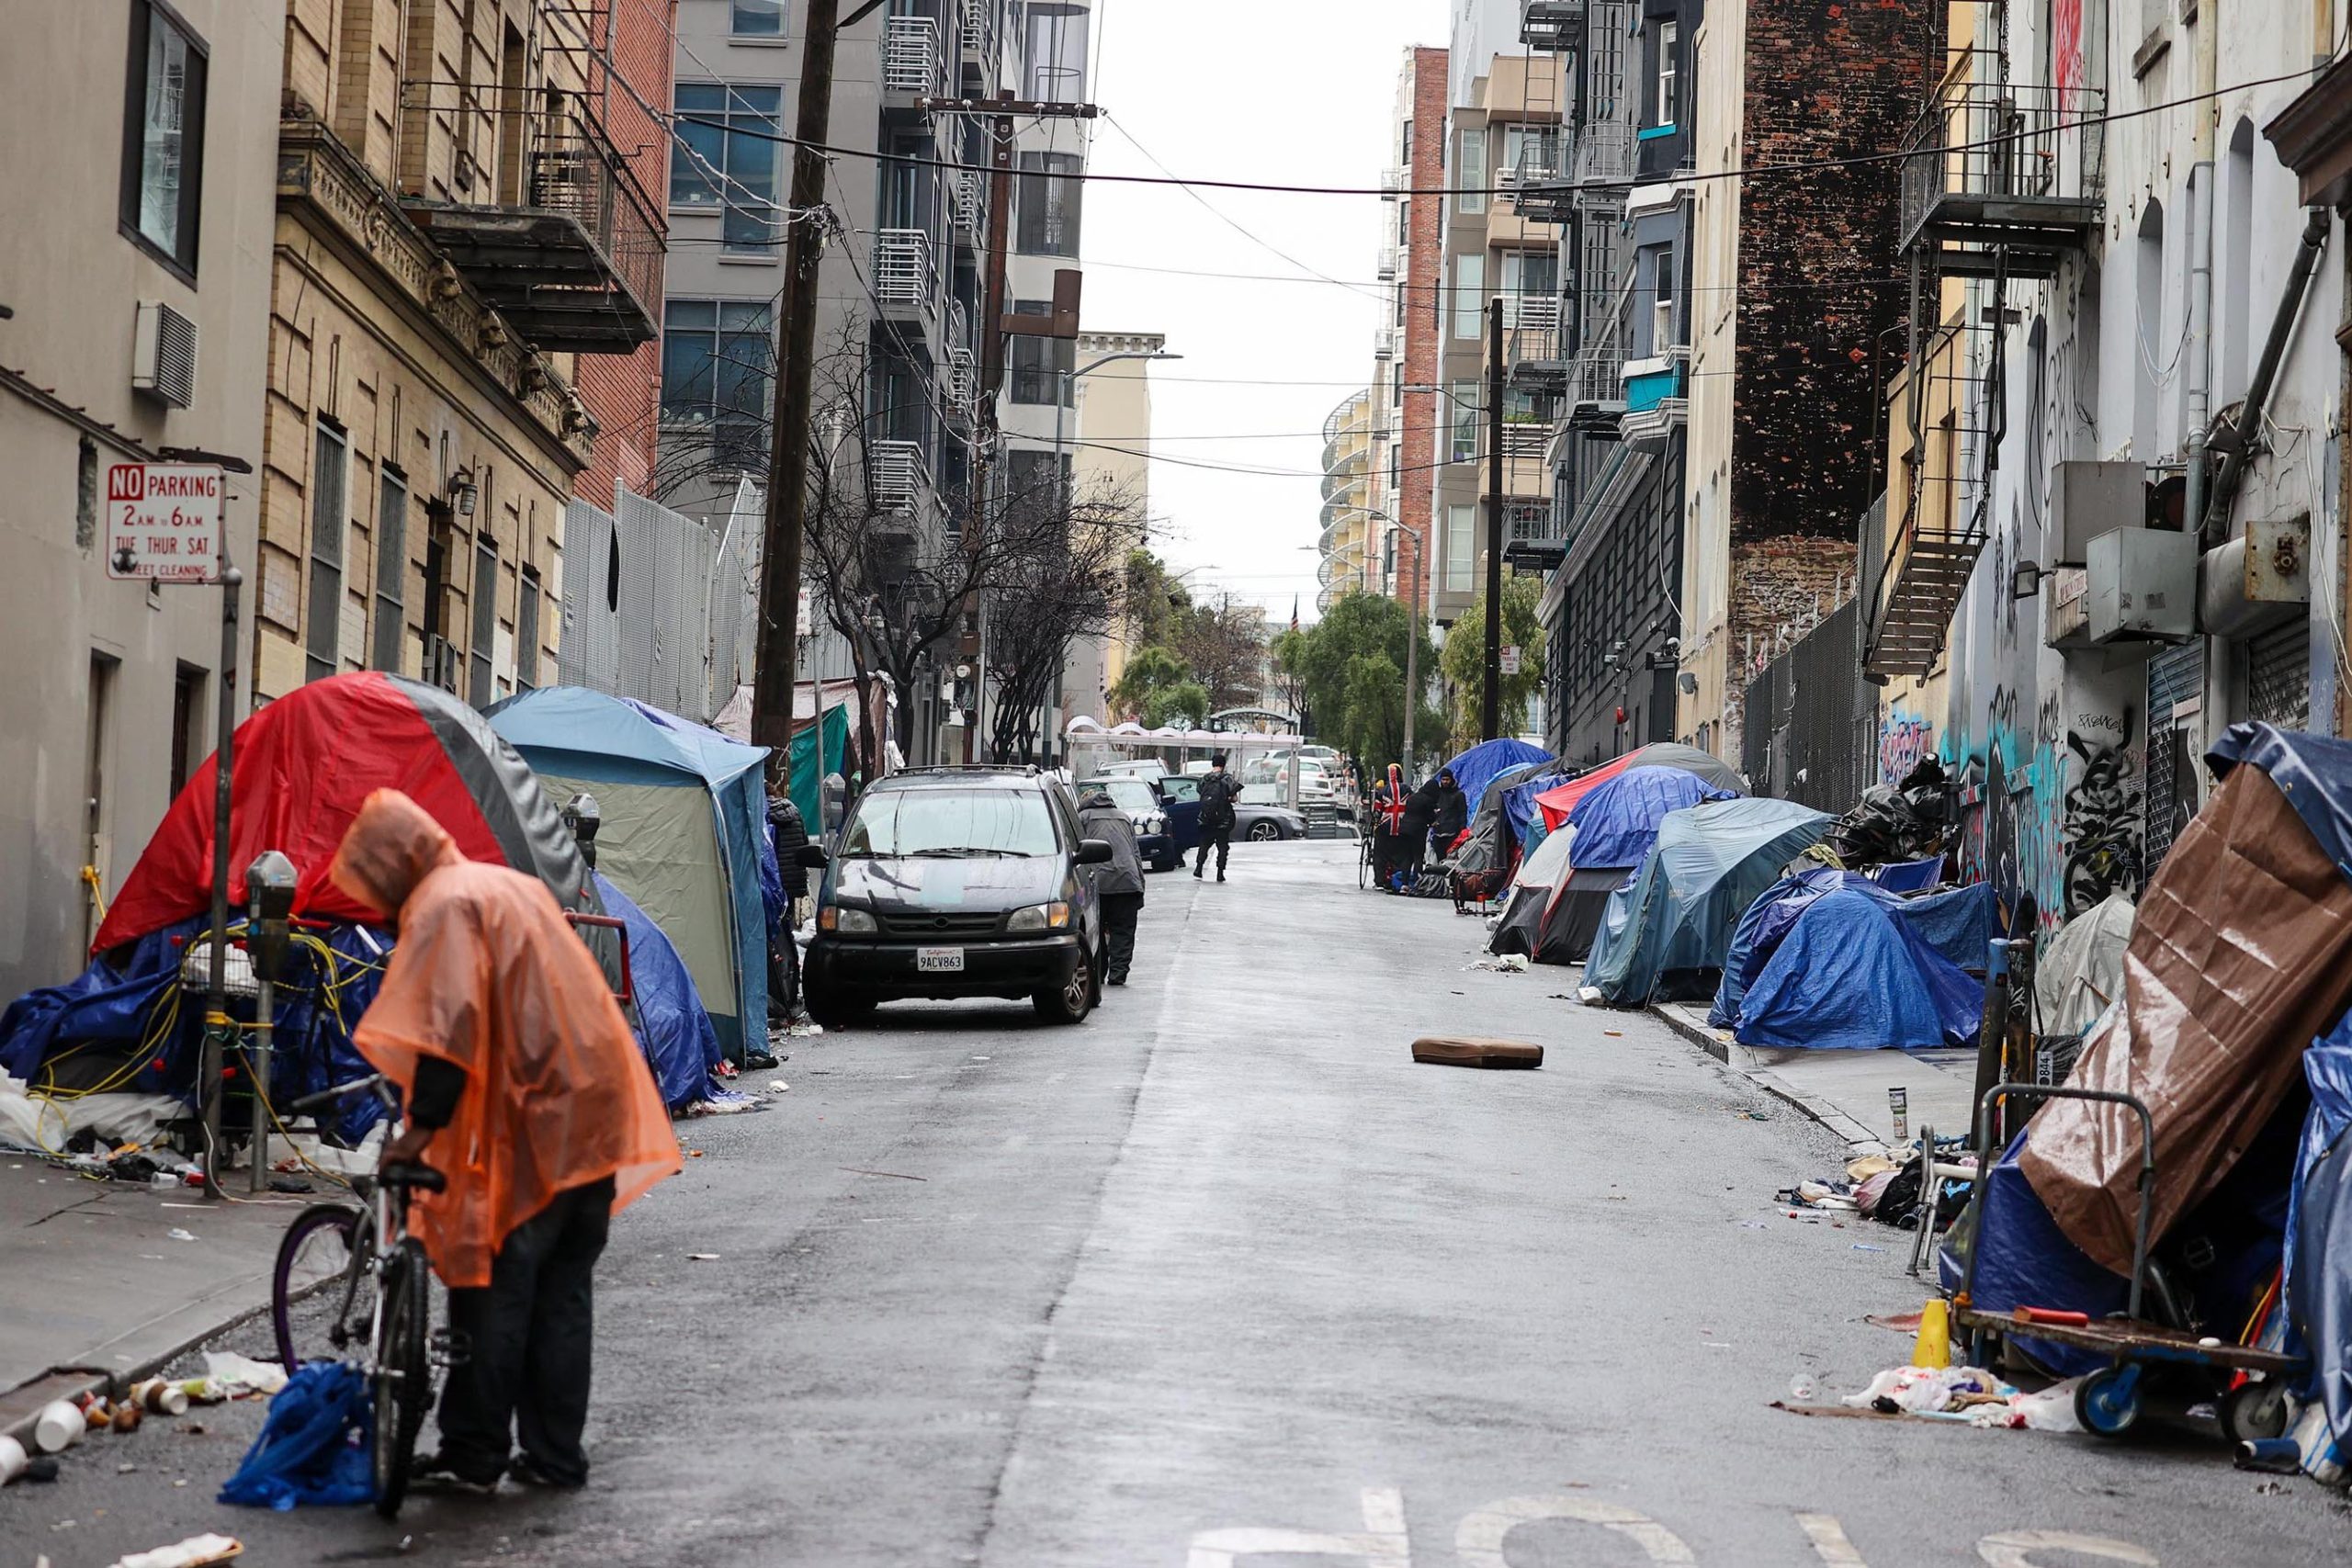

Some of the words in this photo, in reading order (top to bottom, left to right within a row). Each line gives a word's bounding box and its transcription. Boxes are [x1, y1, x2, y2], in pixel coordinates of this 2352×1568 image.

[111, 468, 141, 498] NO
[148, 475, 216, 497] PARKING
[159, 564, 207, 576] CLEANING
[921, 956, 961, 967] 9ACV863
